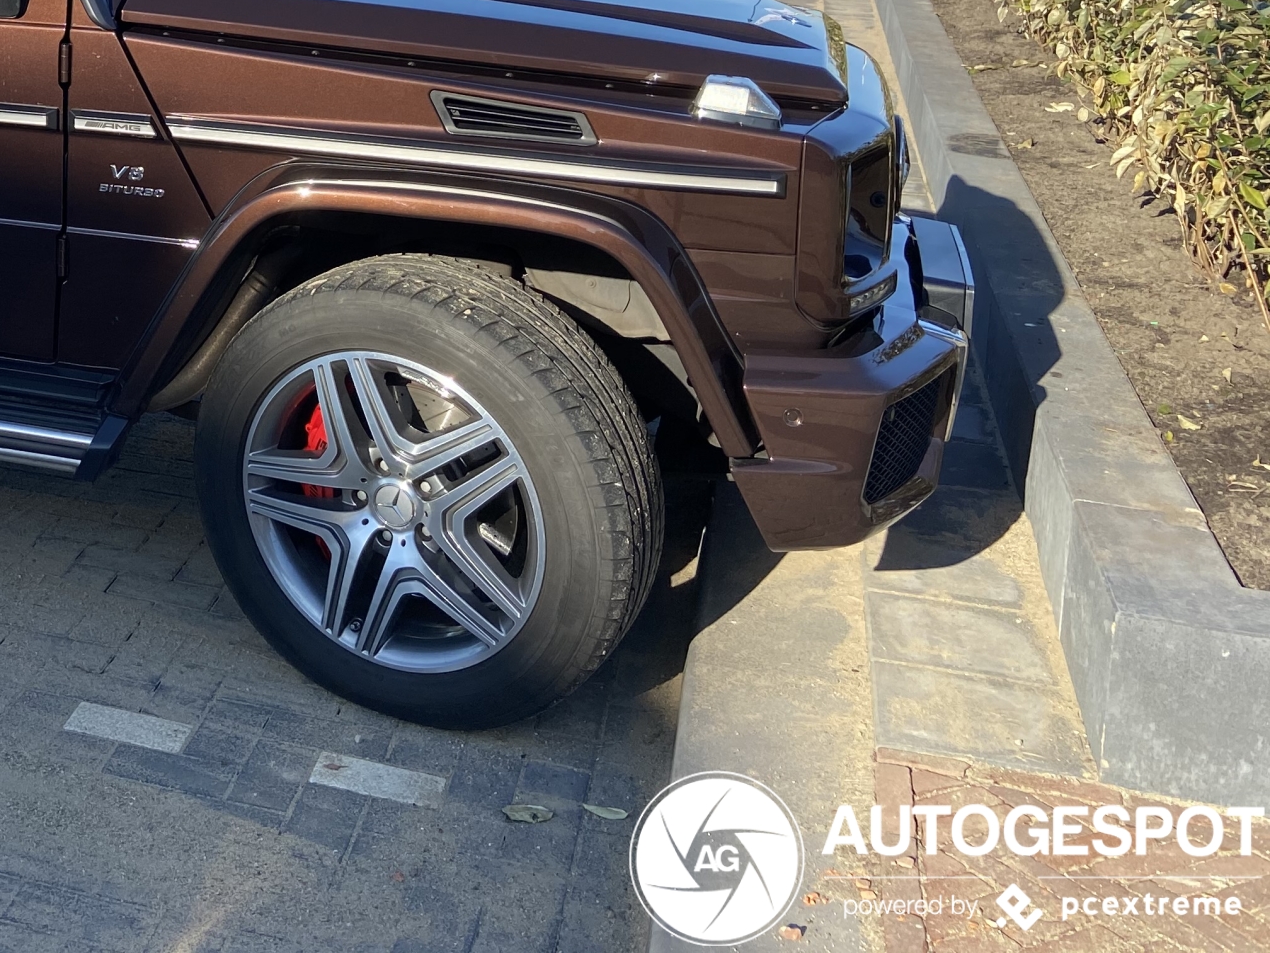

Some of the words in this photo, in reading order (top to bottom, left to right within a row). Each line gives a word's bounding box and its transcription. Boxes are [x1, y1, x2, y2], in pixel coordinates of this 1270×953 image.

[101, 123, 141, 132] AMG
[110, 164, 145, 181] V8
[98, 183, 165, 198] BITURBO
